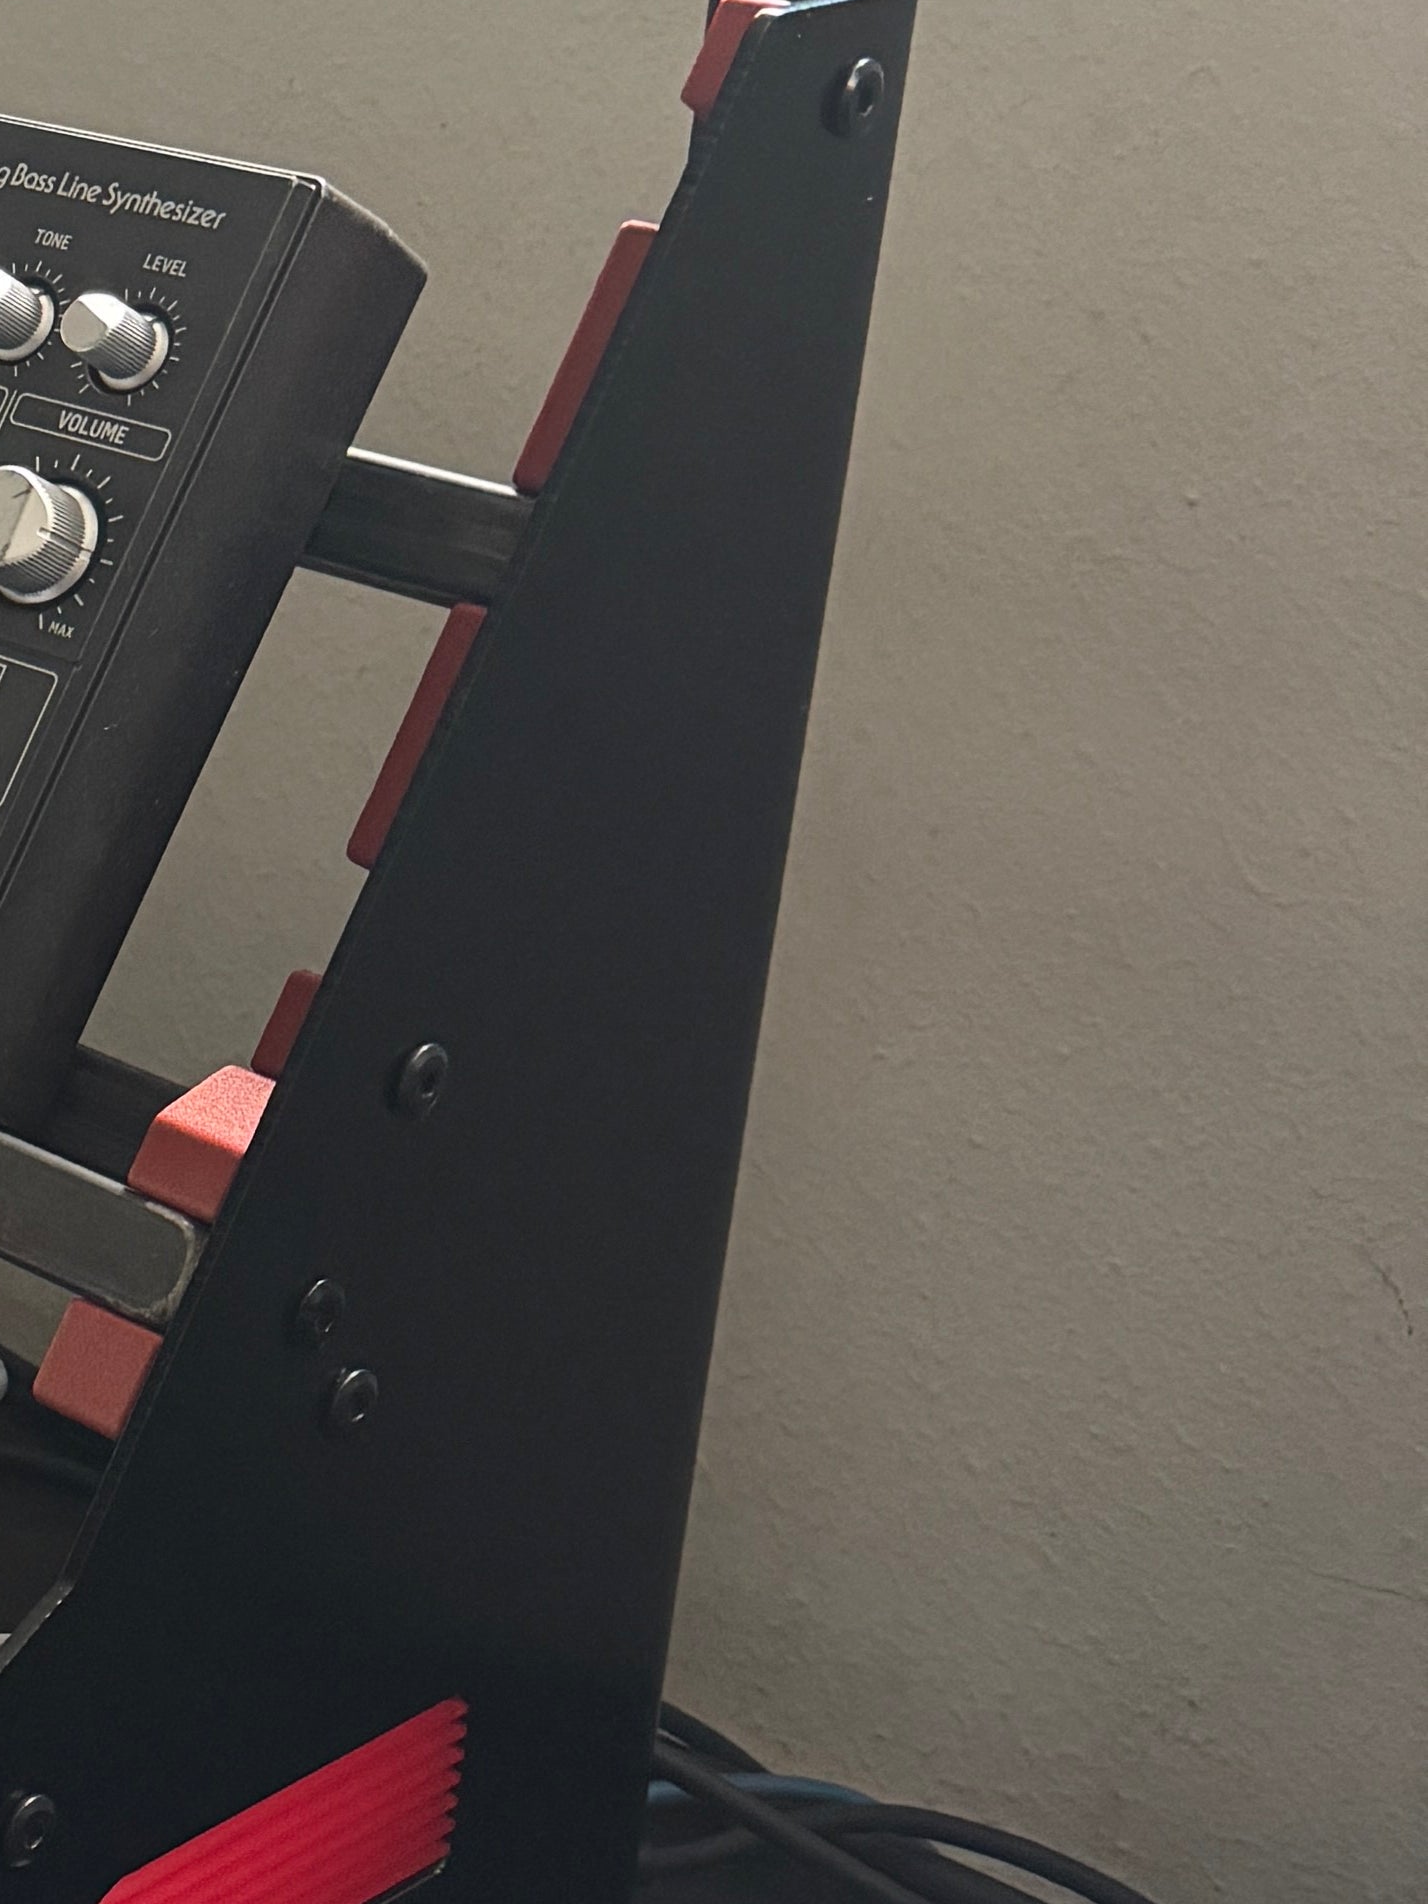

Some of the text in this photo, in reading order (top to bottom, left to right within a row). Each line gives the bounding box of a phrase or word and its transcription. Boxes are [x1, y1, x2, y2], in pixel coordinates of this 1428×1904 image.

[11, 163, 56, 193] Bass
[57, 172, 101, 203] Line
[102, 182, 226, 230] Synthesizer
[34, 228, 72, 250] TONE
[143, 253, 187, 278] LEVEL
[58, 410, 129, 446] VOLUME
[48, 620, 75, 639] MAX
